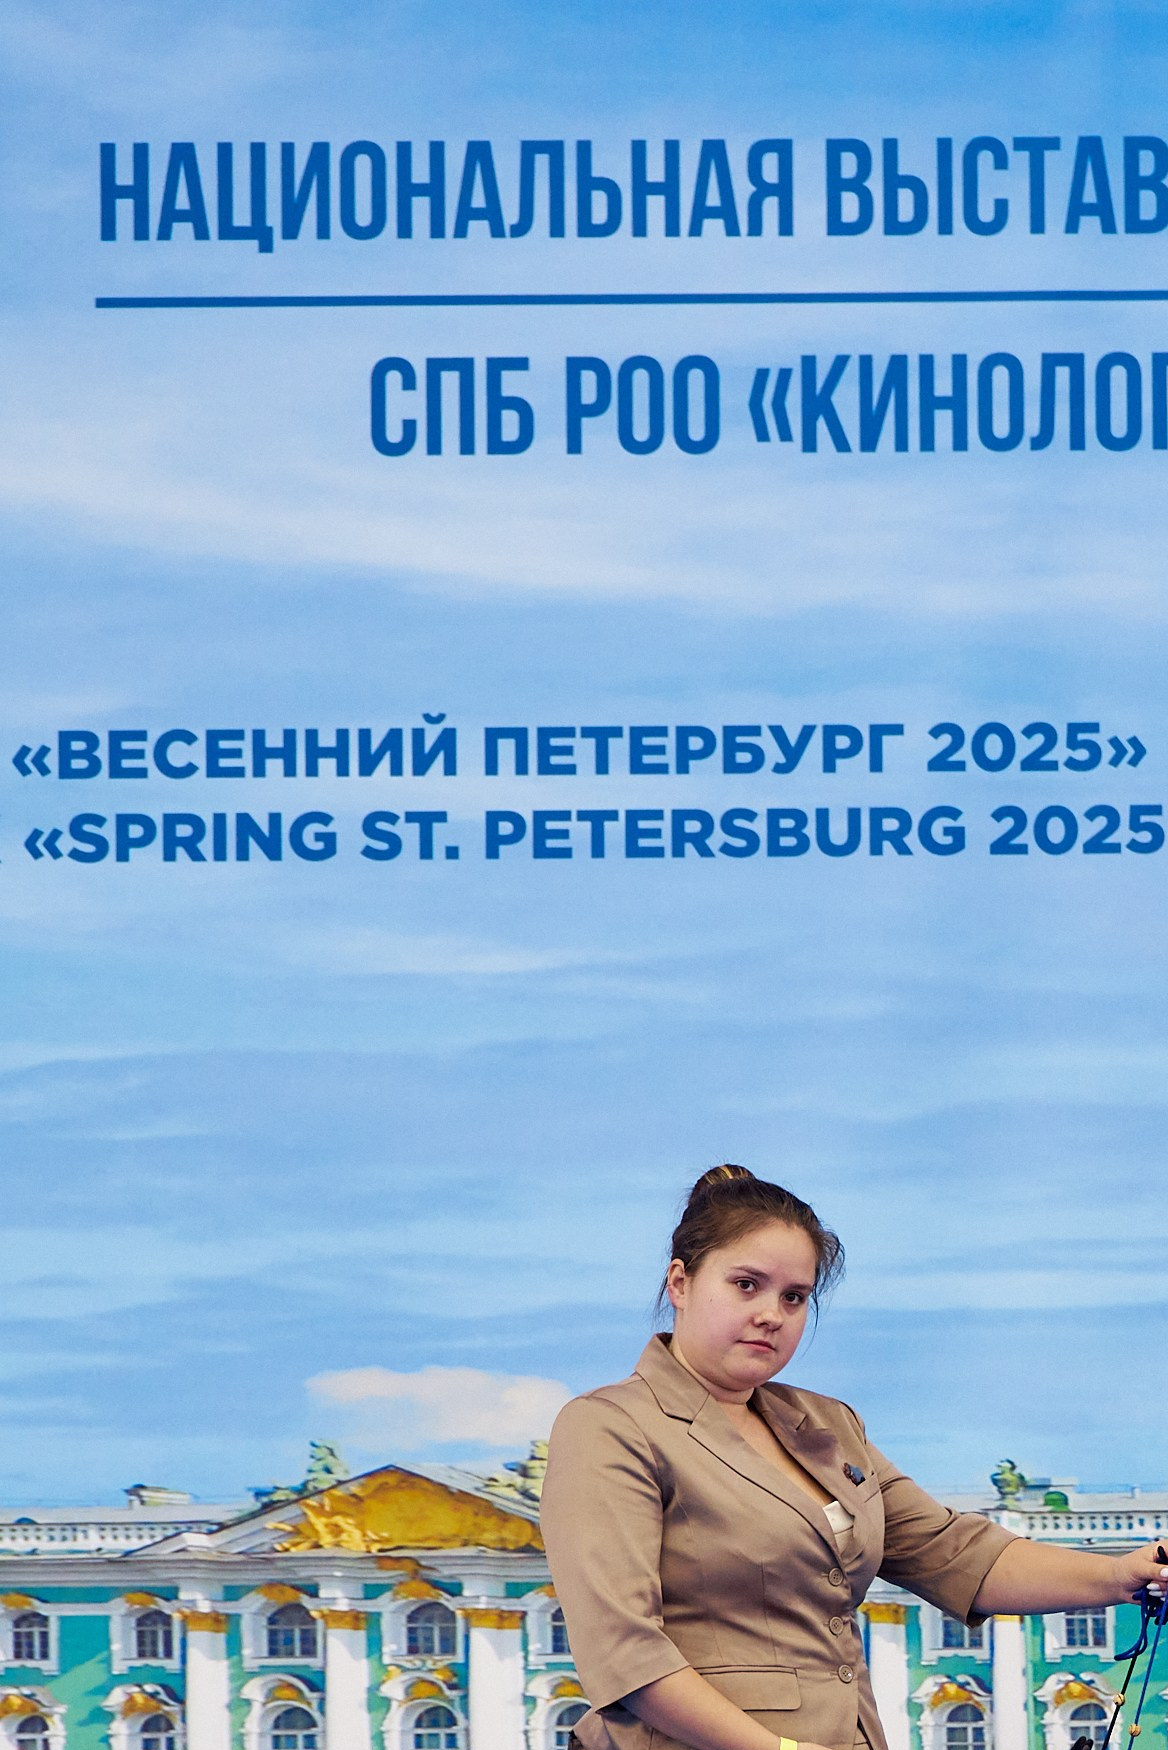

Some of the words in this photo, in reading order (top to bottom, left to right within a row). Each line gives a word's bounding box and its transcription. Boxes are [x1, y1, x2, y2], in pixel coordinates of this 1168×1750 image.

[100, 139, 793, 253] НАЦИОНАЛЬНАЯ
[371, 357, 534, 456] СПБ
[566, 355, 720, 455] РОО
[13, 713, 456, 779] «ВЕСЕННИЙ
[485, 724, 904, 775] ПЕТЕРБУРГ
[928, 722, 1146, 772] 2025»
[25, 812, 336, 863] «SPRING
[361, 811, 459, 861] ST.
[486, 806, 965, 859] PETERSBURG
